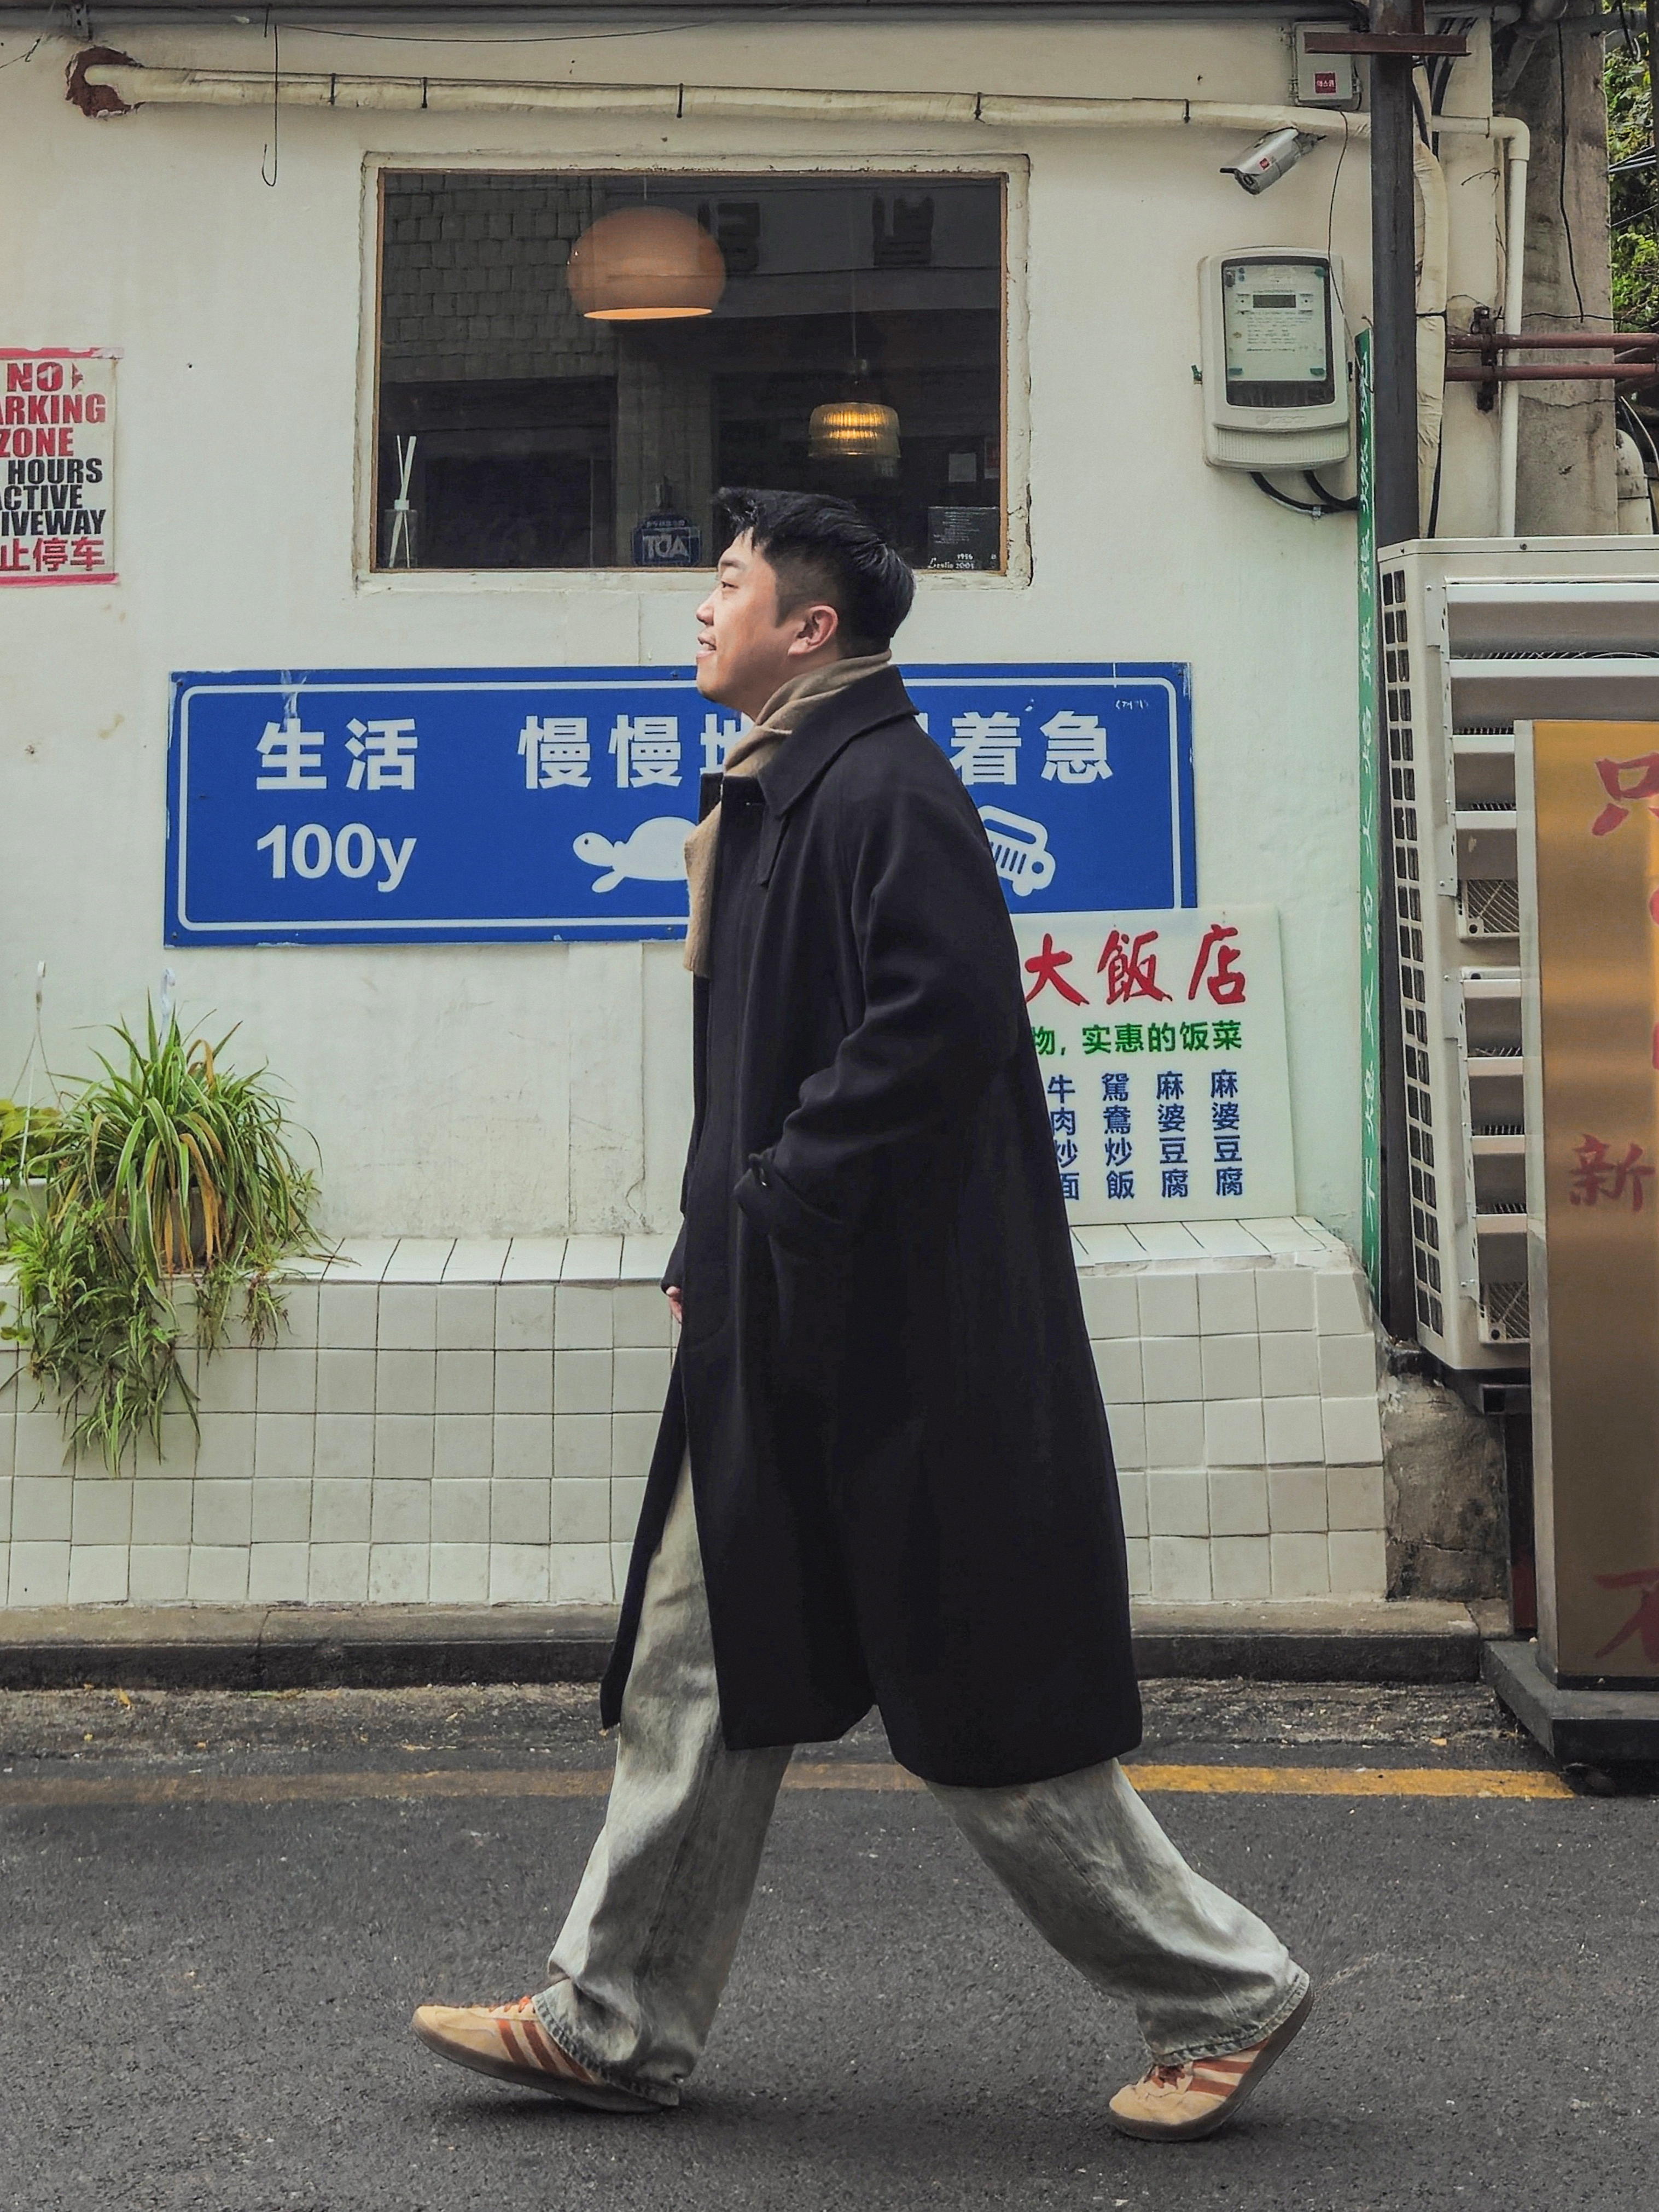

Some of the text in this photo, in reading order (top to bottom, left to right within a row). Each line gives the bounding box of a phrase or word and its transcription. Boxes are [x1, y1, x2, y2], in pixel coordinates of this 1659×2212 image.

[0, 393, 106, 425] RKING
[7, 361, 63, 392] NO
[0, 485, 83, 511] CTIVE
[8, 458, 103, 485] HOURS
[0, 536, 106, 572] 止停车
[256, 717, 418, 790] 生活
[913, 710, 1113, 785] 着急
[256, 822, 417, 892] 100y
[1024, 924, 1247, 1007] 大飯店
[1156, 1070, 1189, 1198] 麻婆豆腐
[1210, 1069, 1243, 1197] 麻婆豆腐
[1568, 1134, 1656, 1212] 新
